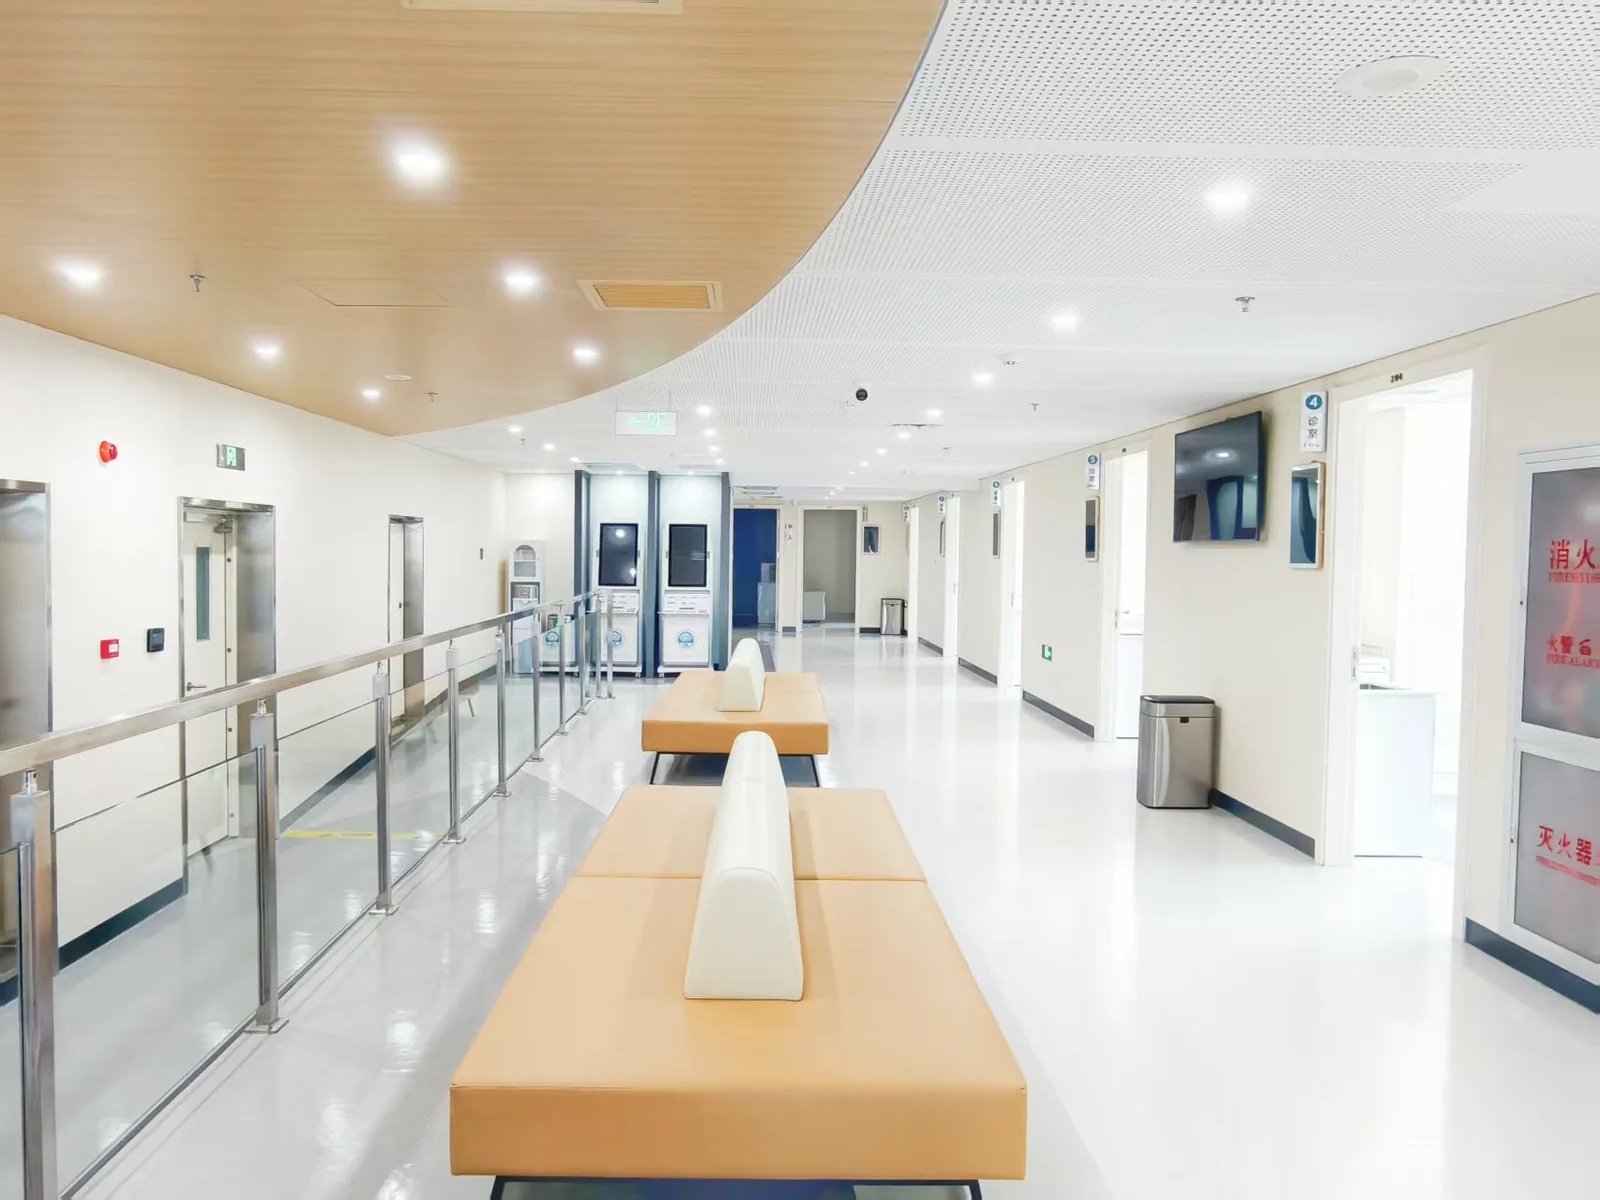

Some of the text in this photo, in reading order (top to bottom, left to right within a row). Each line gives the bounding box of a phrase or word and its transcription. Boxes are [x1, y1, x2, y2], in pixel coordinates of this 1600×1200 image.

[1308, 395, 1320, 408] 4
[1307, 416, 1319, 438] 诊室
[1537, 825, 1600, 867] 灭火器
